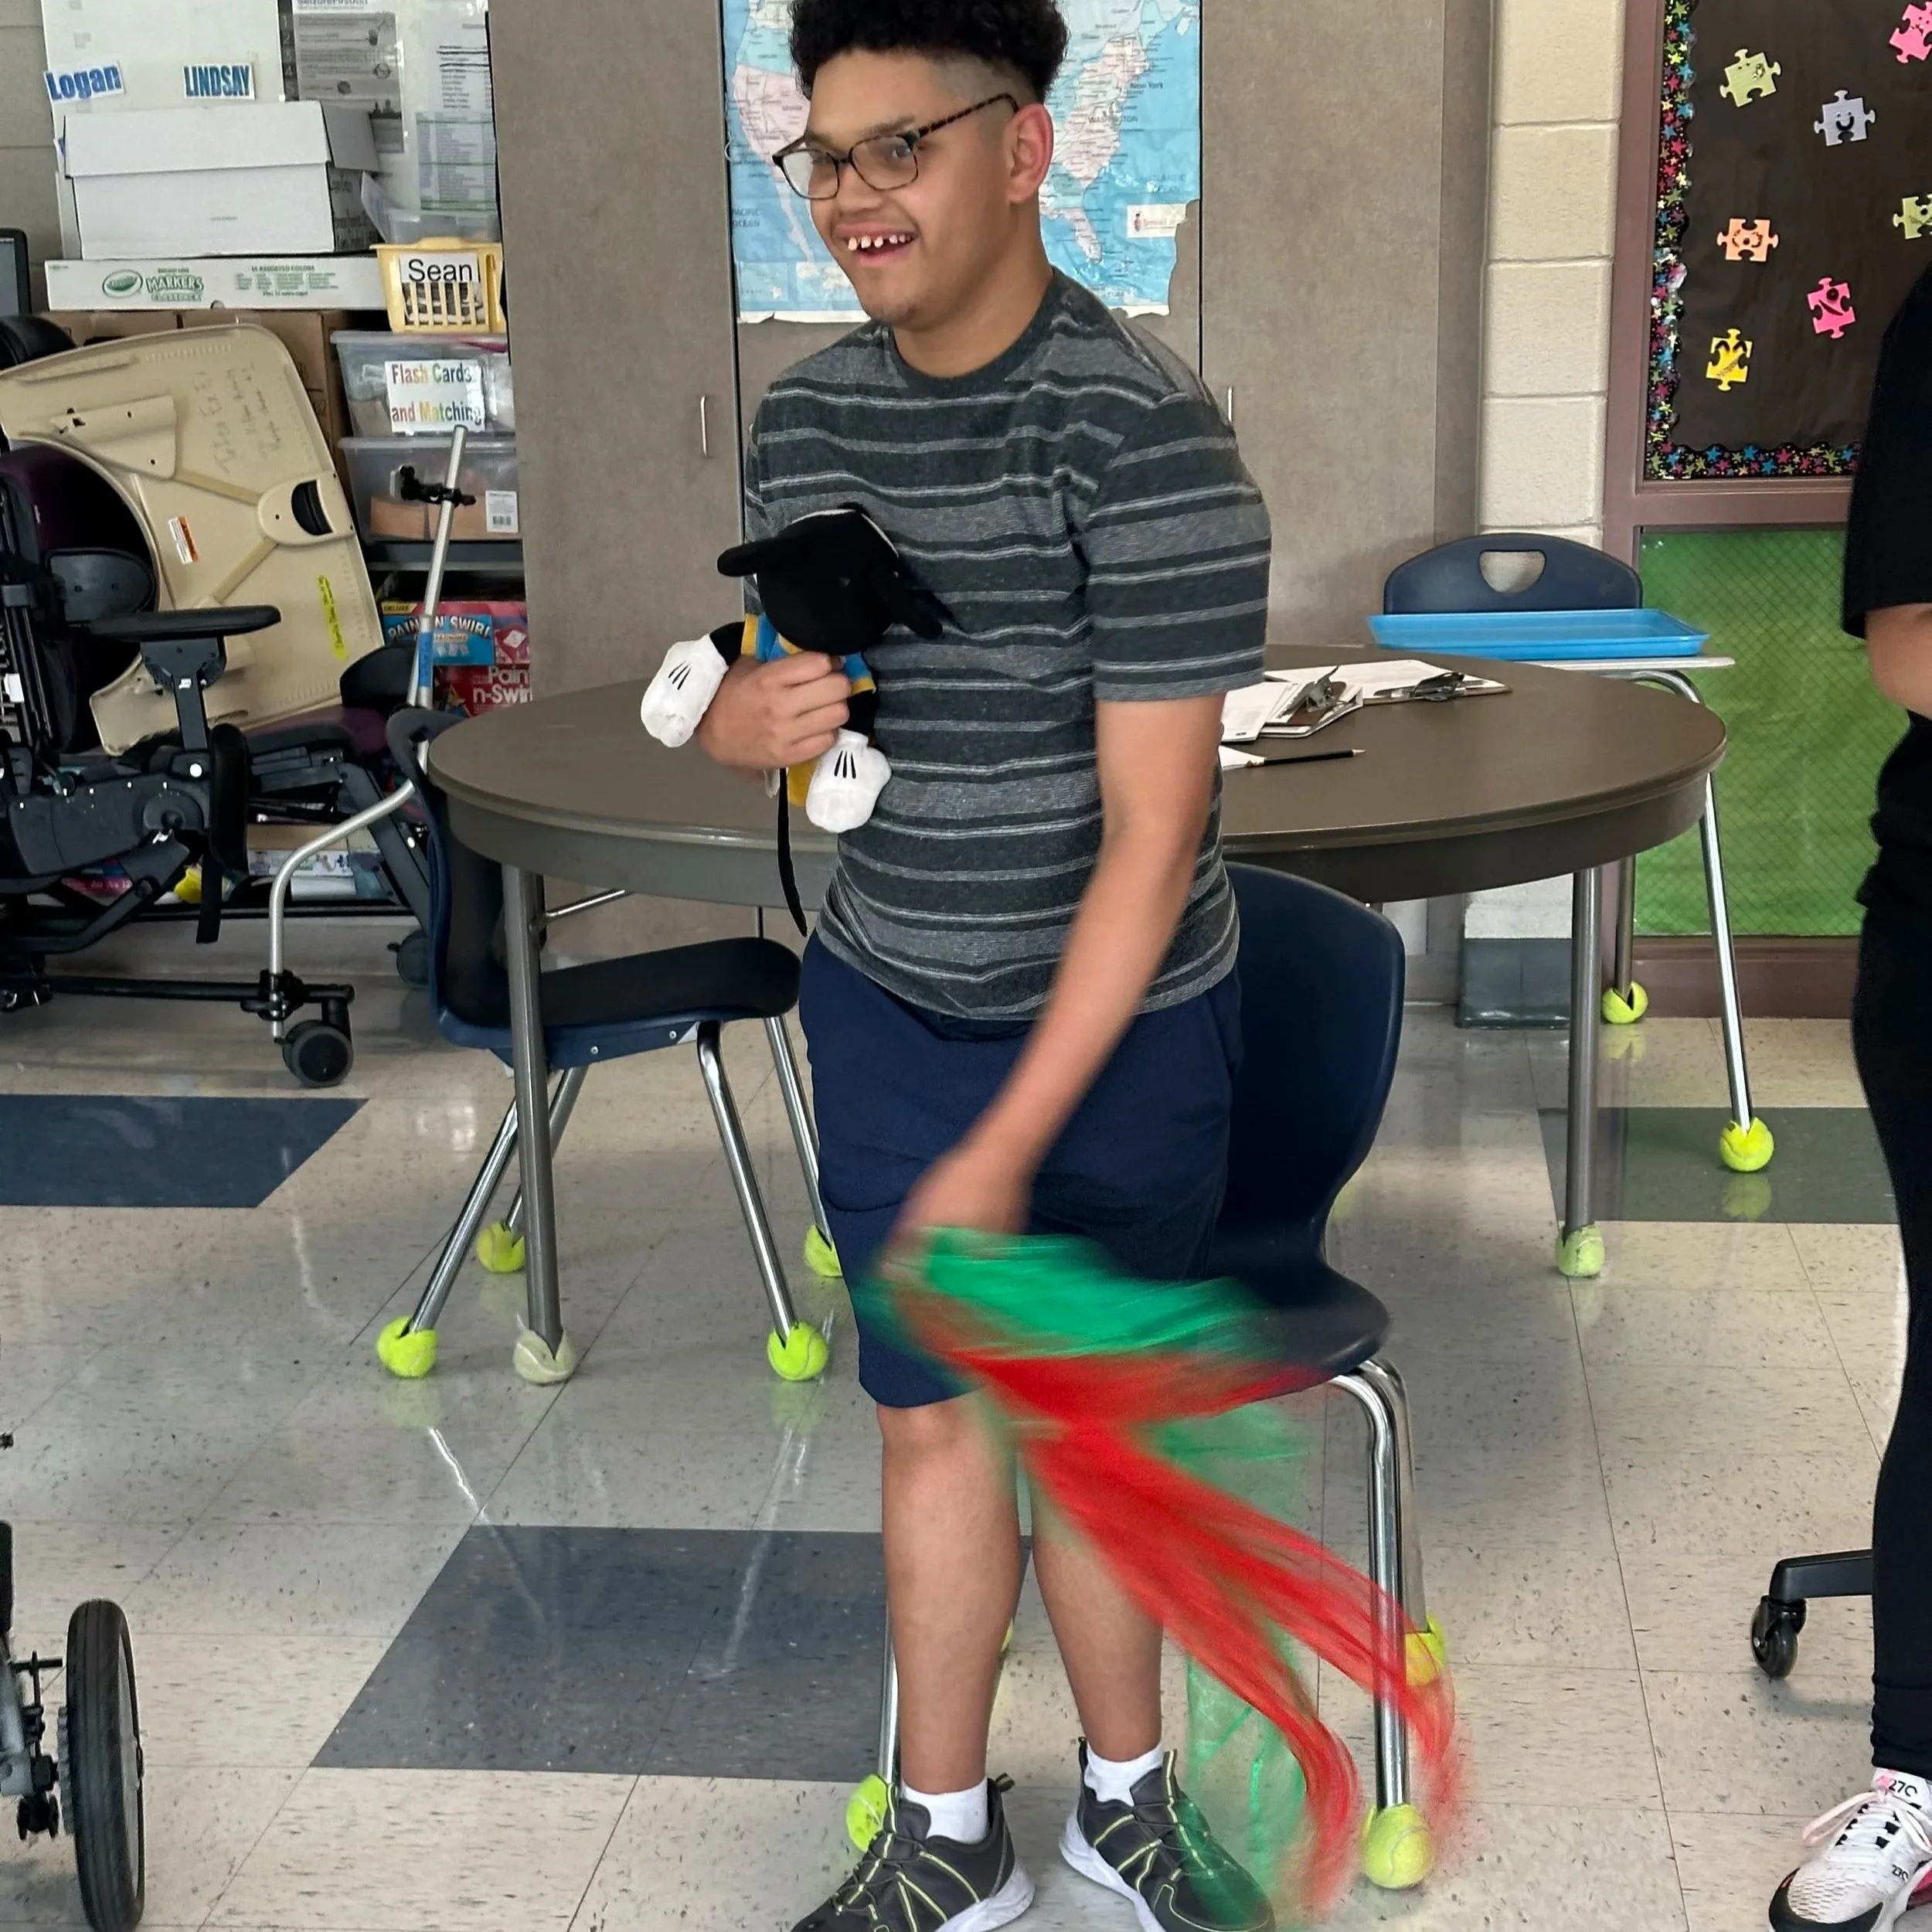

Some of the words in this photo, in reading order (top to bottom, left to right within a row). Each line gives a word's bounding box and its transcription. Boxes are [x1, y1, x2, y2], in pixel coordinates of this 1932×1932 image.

[46, 65, 121, 100] Logan
[184, 65, 250, 97] LINDSAY
[408, 259, 472, 282] Sean
[145, 274, 204, 293] MARKERS
[391, 364, 428, 384] Flash
[392, 402, 416, 423] and
[420, 400, 482, 426] Matching
